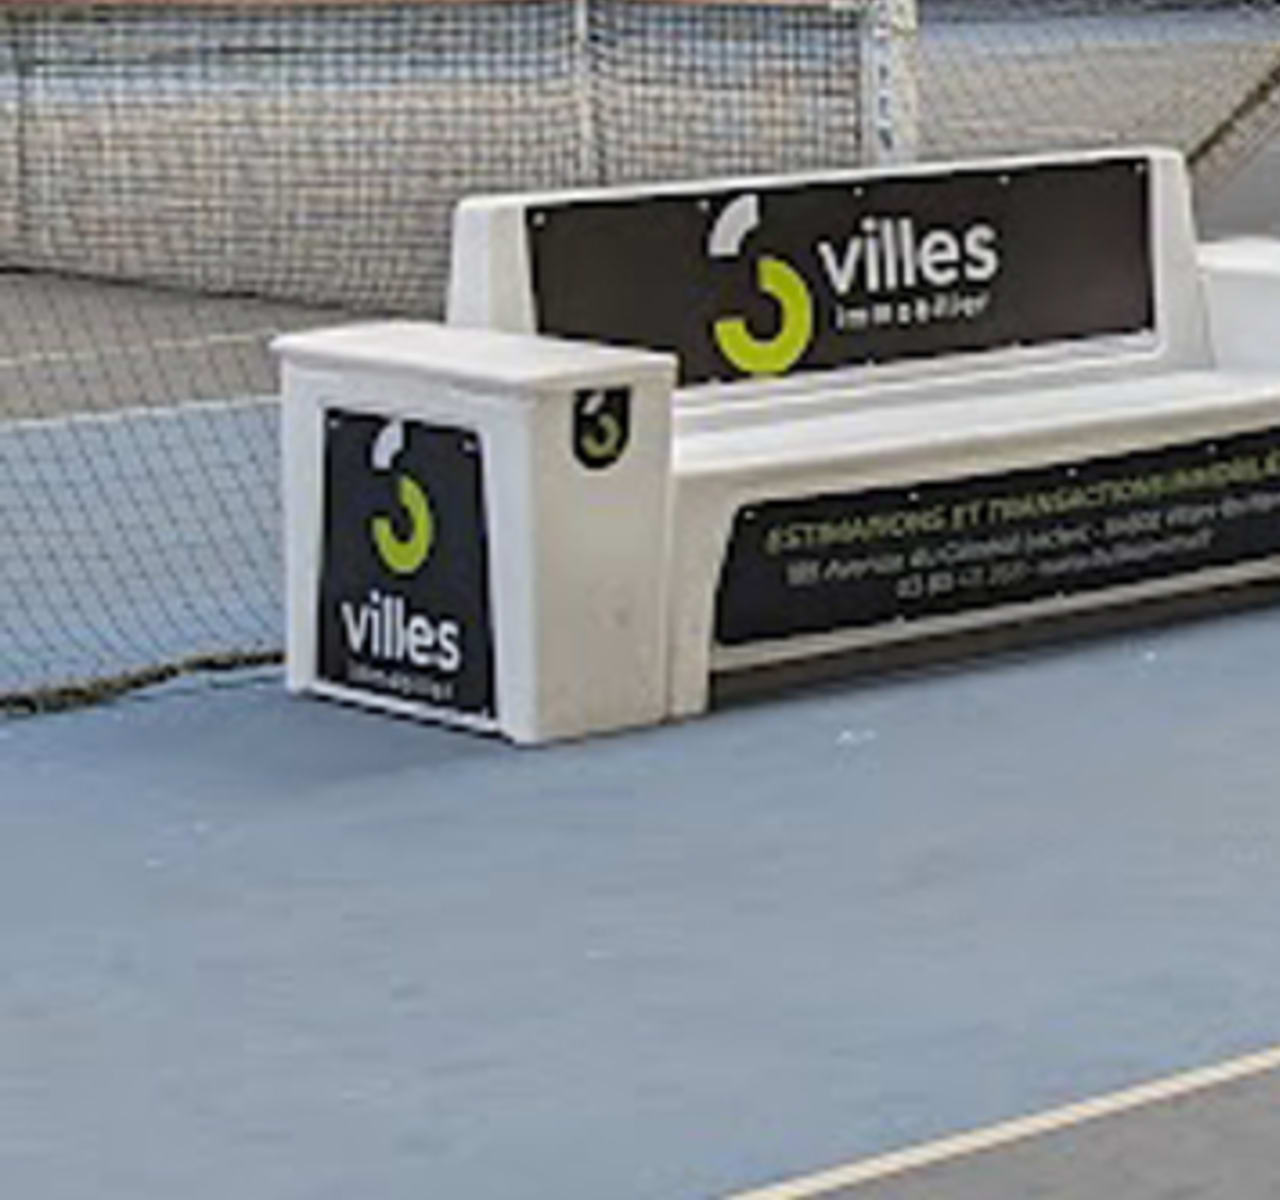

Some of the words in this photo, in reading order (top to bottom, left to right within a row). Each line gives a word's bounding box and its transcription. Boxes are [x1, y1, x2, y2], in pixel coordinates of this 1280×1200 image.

[708, 194, 814, 374] 3
[817, 217, 999, 295] villes
[835, 290, 993, 331] immobilier
[341, 589, 462, 673] villes
